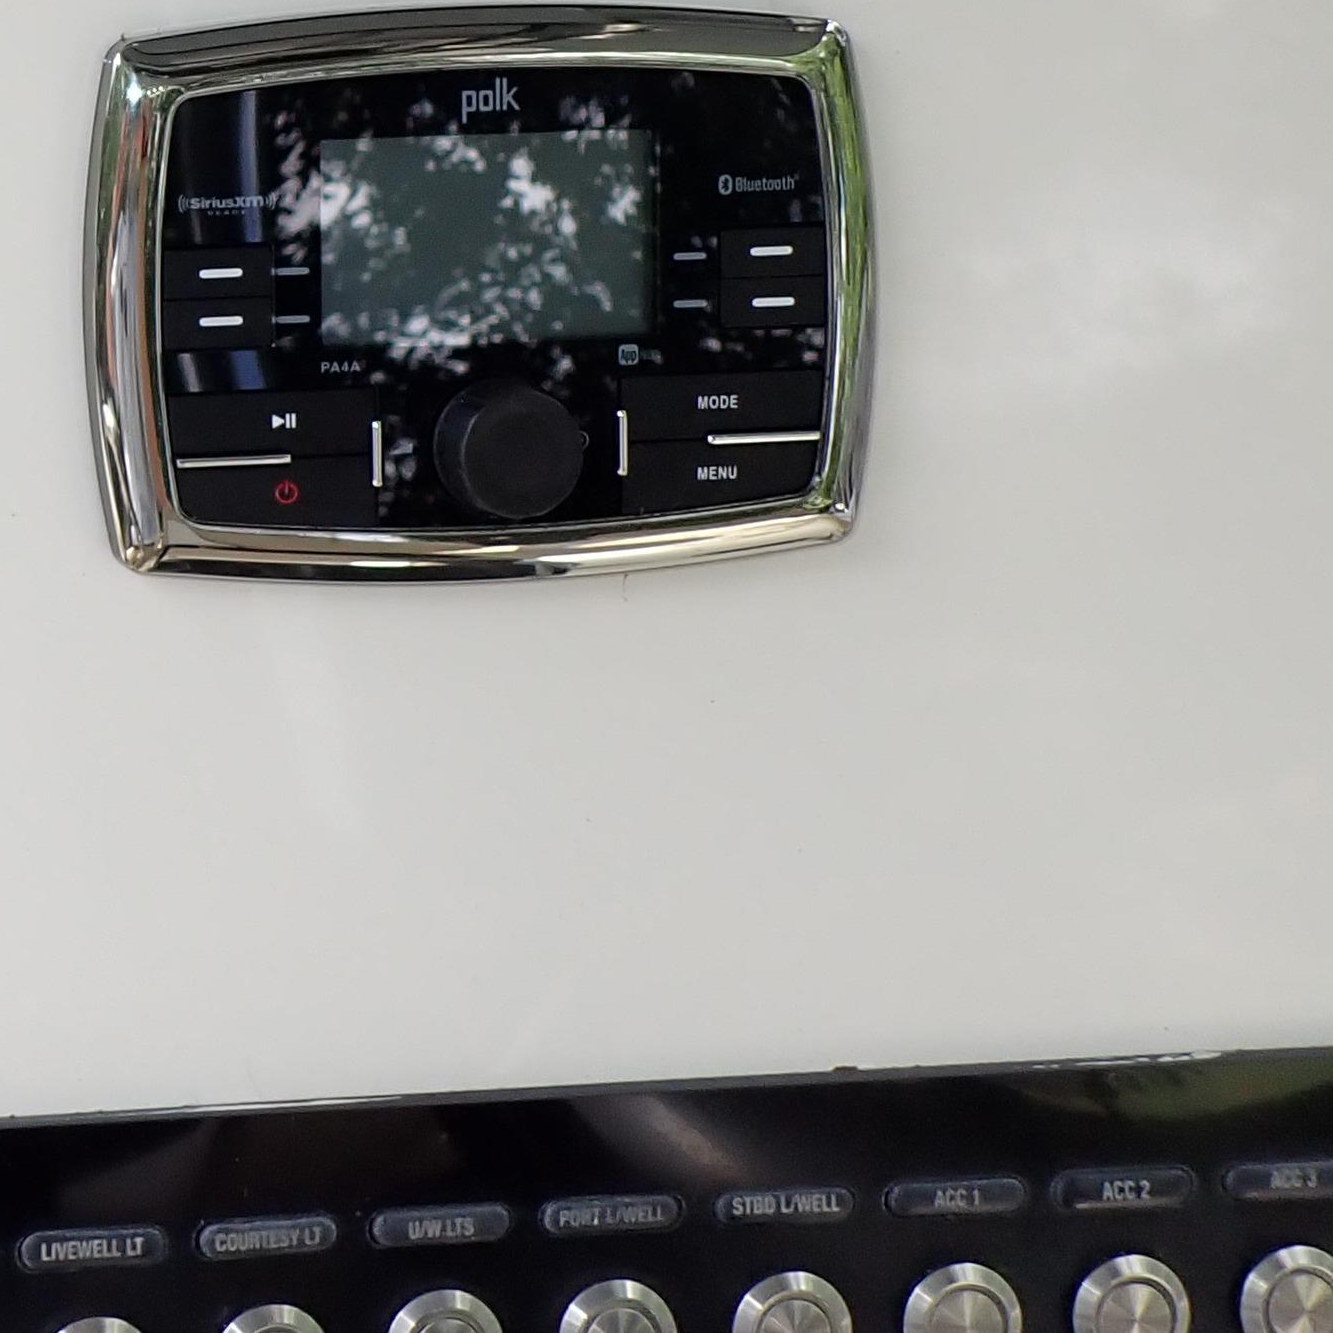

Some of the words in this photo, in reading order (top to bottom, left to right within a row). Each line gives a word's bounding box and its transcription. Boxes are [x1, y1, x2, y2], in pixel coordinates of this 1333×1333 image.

[462, 76, 520, 124] polk
[735, 175, 795, 193] Bluetooth
[697, 394, 739, 410] MODE
[697, 464, 738, 481] MENU
[1270, 1170, 1304, 1190] ACC
[1308, 1167, 1318, 1188] 3
[934, 1187, 968, 1208] ACC
[972, 1186, 981, 1206] 1
[1102, 1181, 1134, 1202] ACC
[1139, 1179, 1151, 1199] 2
[732, 1196, 775, 1216] STBD
[445, 1217, 476, 1237] LTS
[40, 1239, 121, 1262] LIVEWELL
[126, 1236, 146, 1256] LT
[215, 1228, 301, 1252] COURTESY
[304, 1226, 323, 1246] LT
